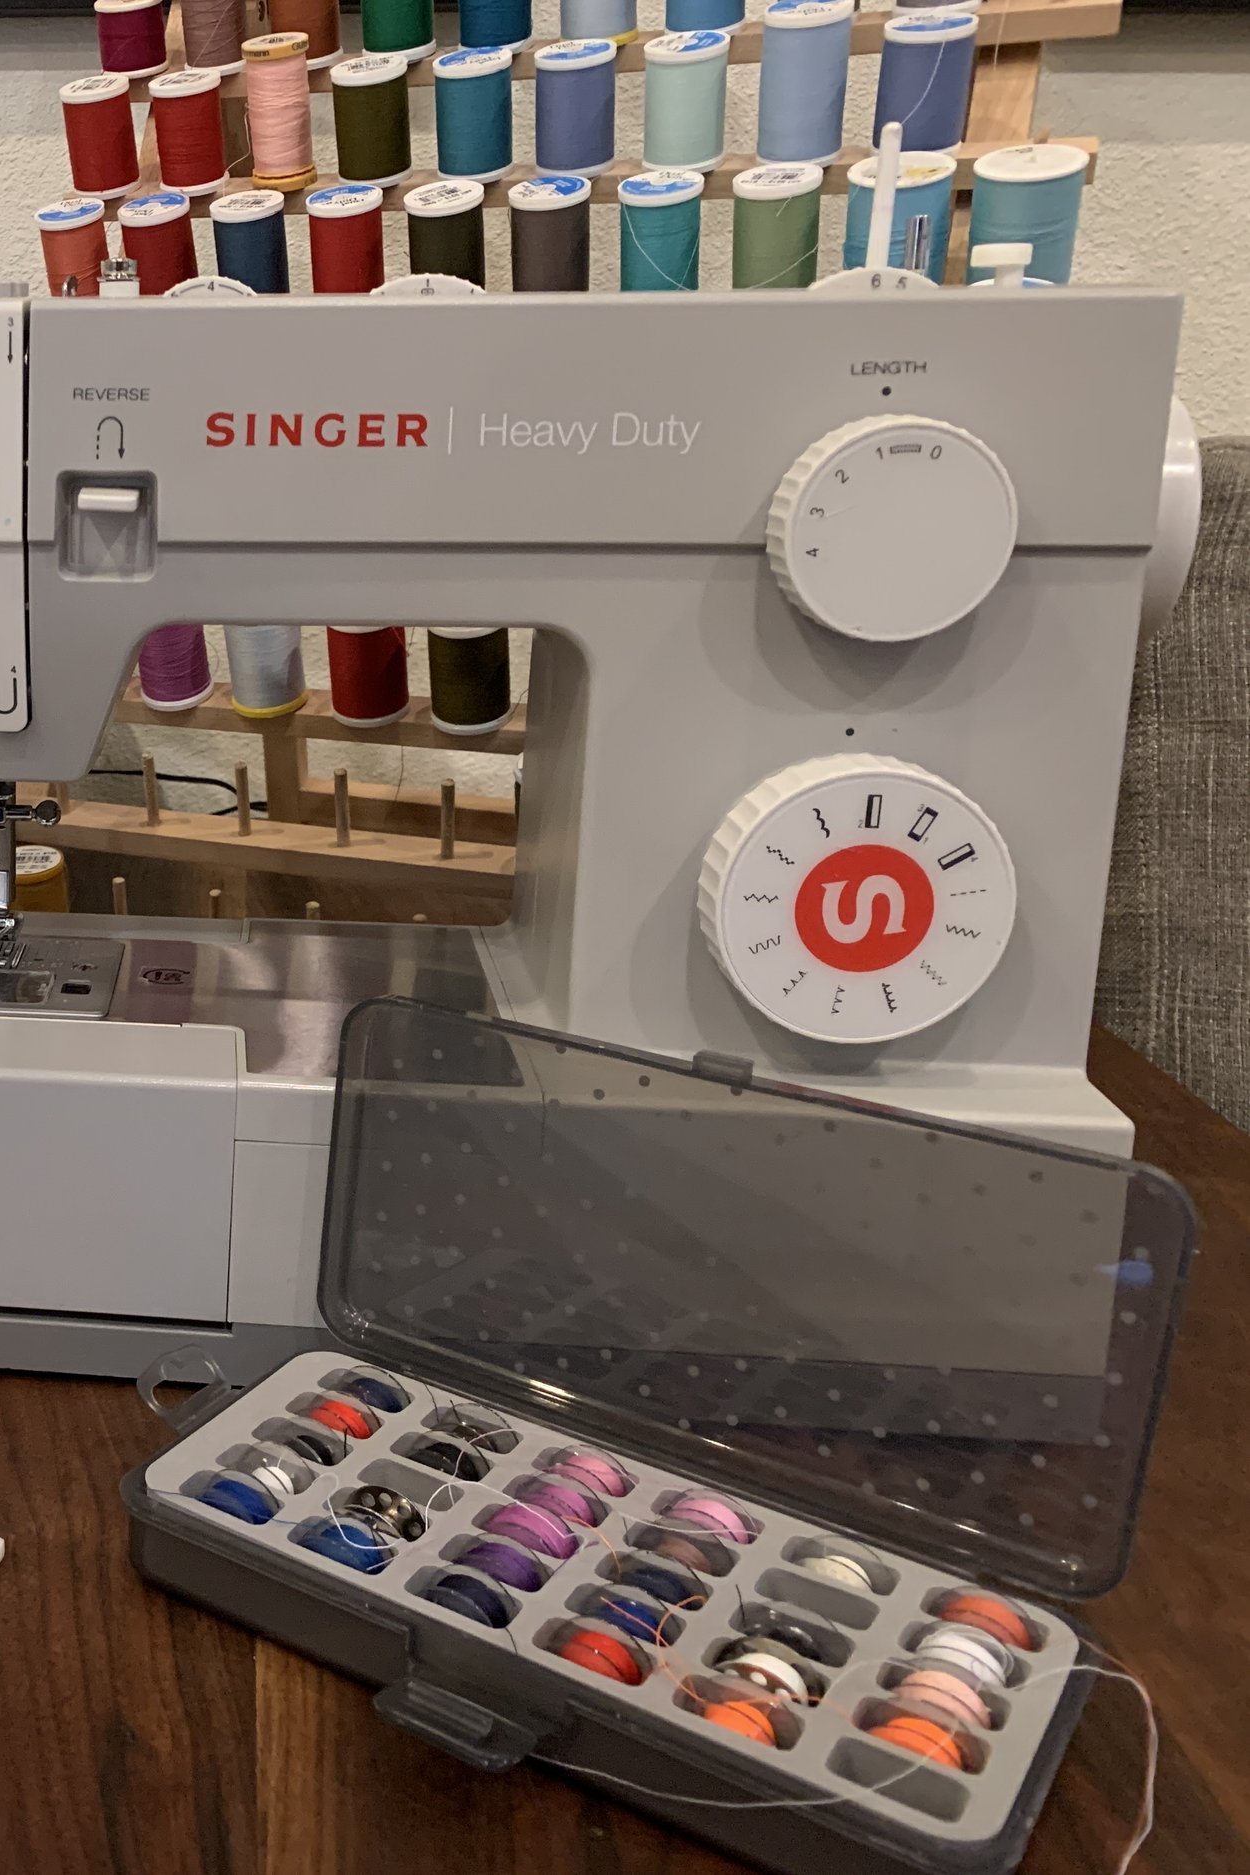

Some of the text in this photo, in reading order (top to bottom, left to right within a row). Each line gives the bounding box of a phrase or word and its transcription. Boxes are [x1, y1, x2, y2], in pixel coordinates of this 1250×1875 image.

[207, 281, 215, 292] 4
[870, 273, 881, 289] 6
[850, 361, 927, 376] LENGTH
[73, 387, 150, 402] REVERSE
[205, 412, 429, 448] SINGER
[479, 413, 701, 455] Heavy Duty
[876, 447, 884, 460] 1
[930, 445, 943, 460] 0
[835, 469, 850, 484] 2
[810, 507, 825, 518] 3
[806, 548, 819, 558] 4
[10, 665, 17, 674] 4
[820, 874, 907, 944] S
